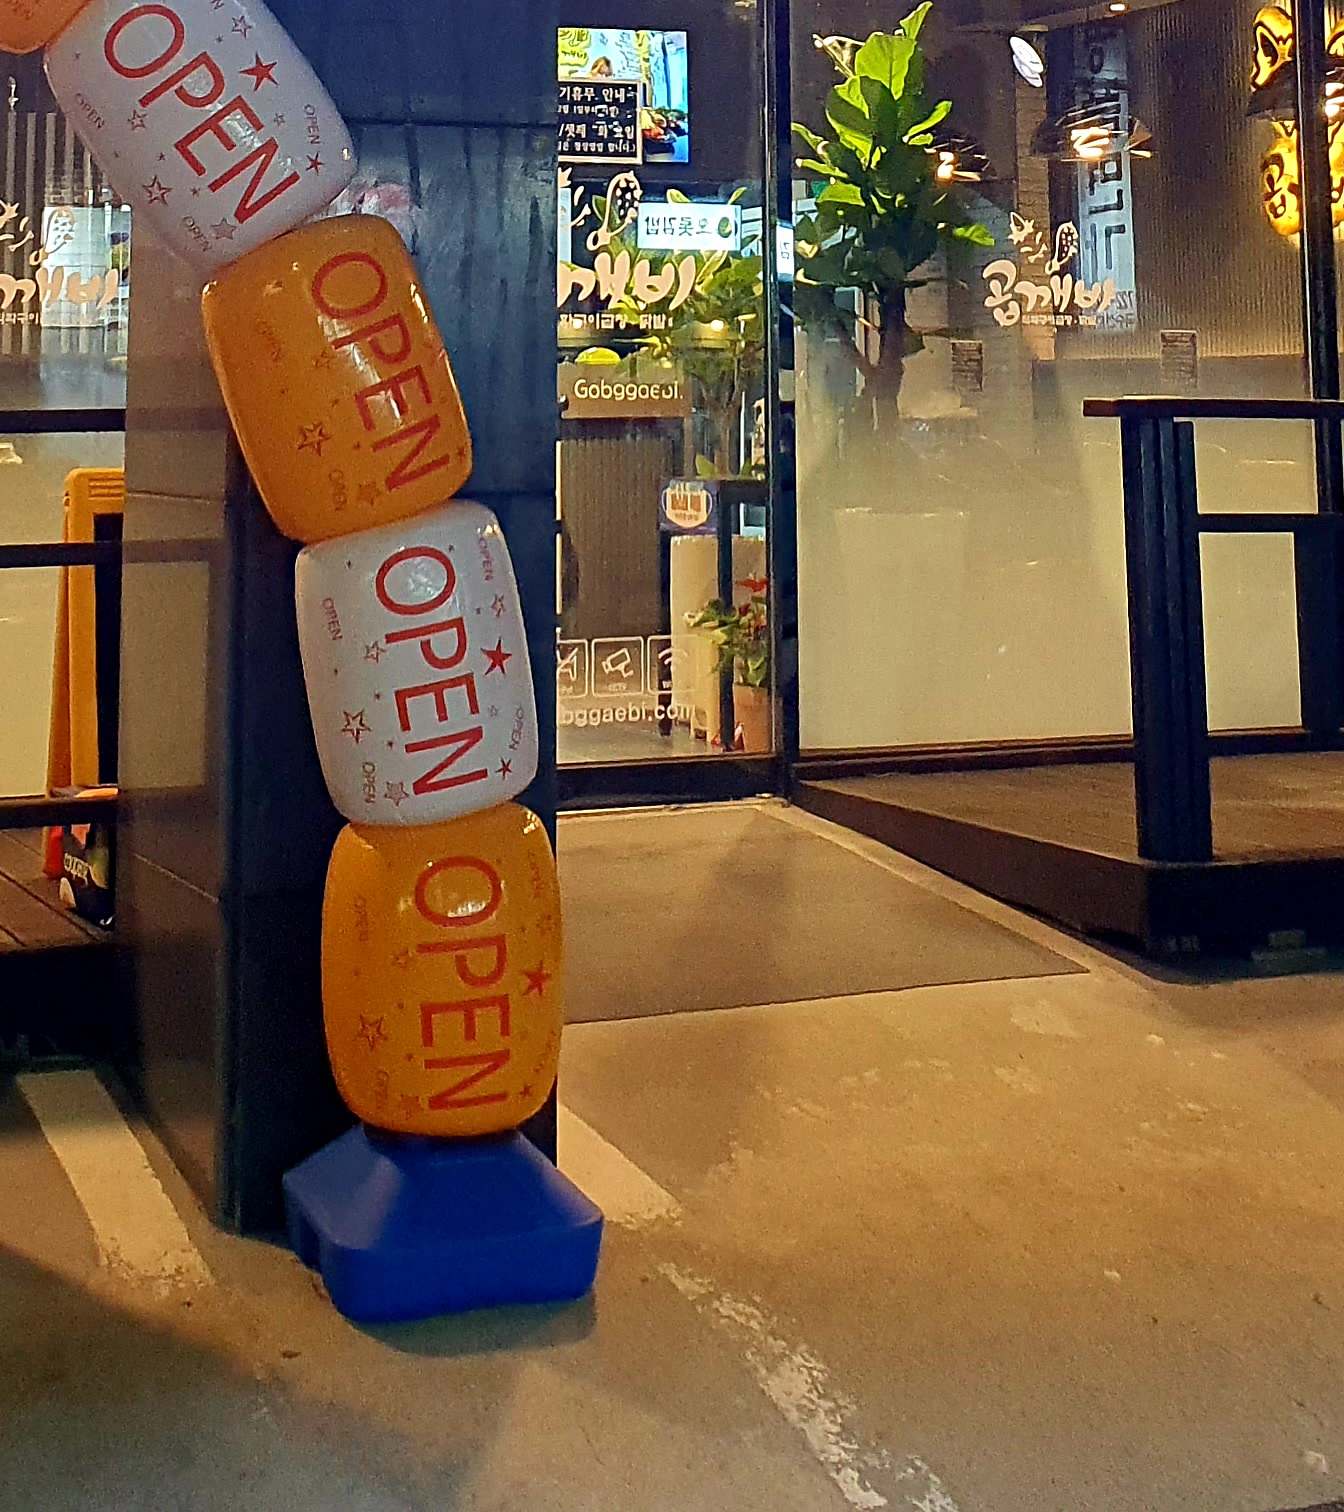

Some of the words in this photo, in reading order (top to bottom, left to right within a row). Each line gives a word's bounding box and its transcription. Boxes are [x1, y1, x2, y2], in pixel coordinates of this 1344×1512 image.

[104, 4, 301, 224] OPEN
[304, 104, 321, 145] OPEN
[602, 87, 625, 103] 안내
[983, 259, 1116, 327] 곱깨비
[311, 252, 451, 493] OPEN
[321, 597, 343, 641] OPEN
[375, 546, 488, 795] OPEN
[414, 856, 509, 1110] OPEN
